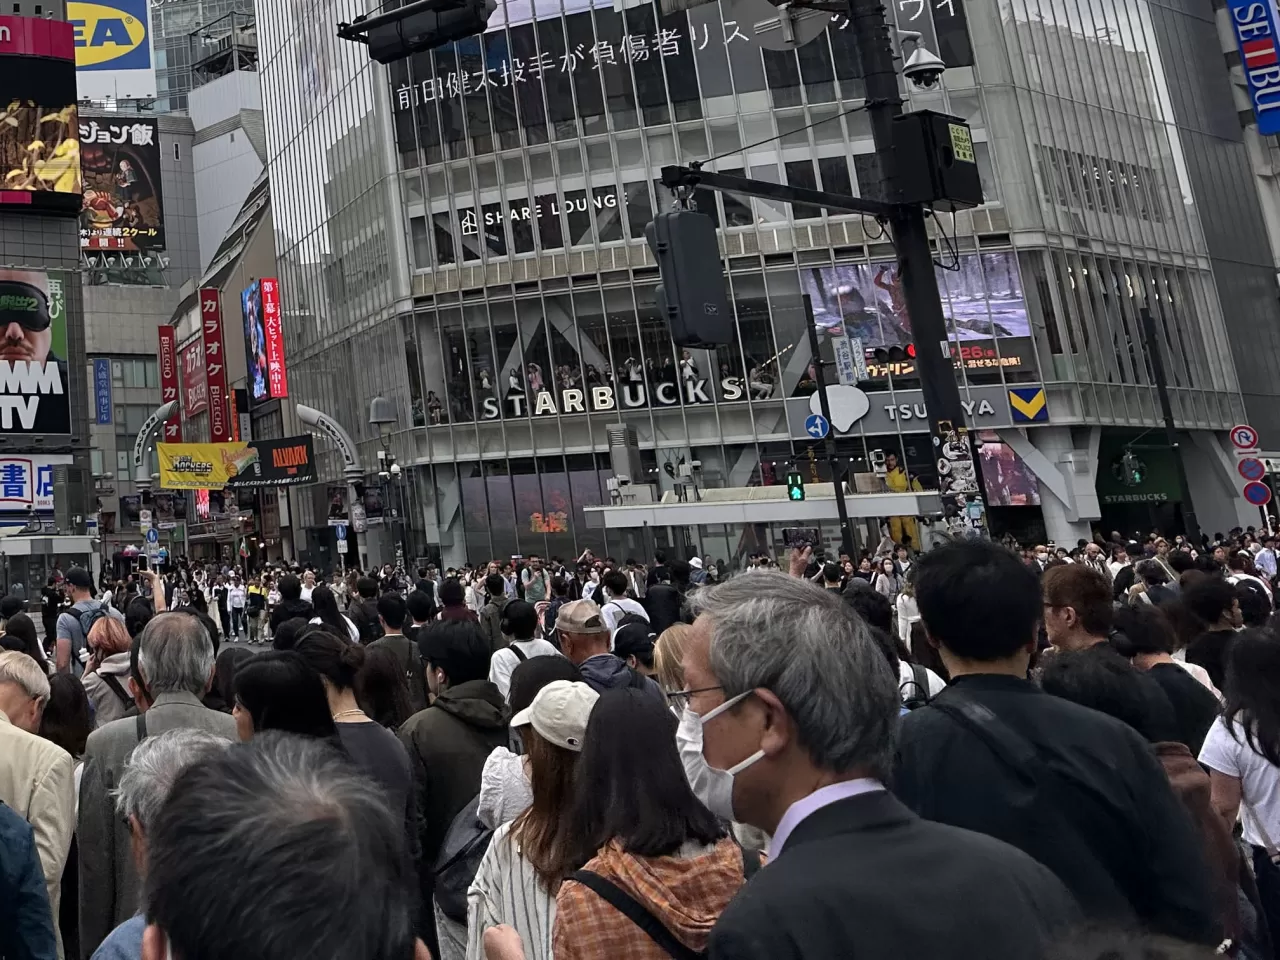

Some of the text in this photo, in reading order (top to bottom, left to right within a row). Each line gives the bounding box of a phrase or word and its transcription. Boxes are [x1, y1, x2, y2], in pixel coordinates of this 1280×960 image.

[1233, 2, 1280, 115] SEIBU
[485, 192, 631, 227] SHARE LOUNGE
[46, 278, 63, 319] 再び
[203, 298, 223, 377] カラオケ
[483, 376, 744, 420] STARBUCKS
[1104, 493, 1168, 503] STARBUCKS
